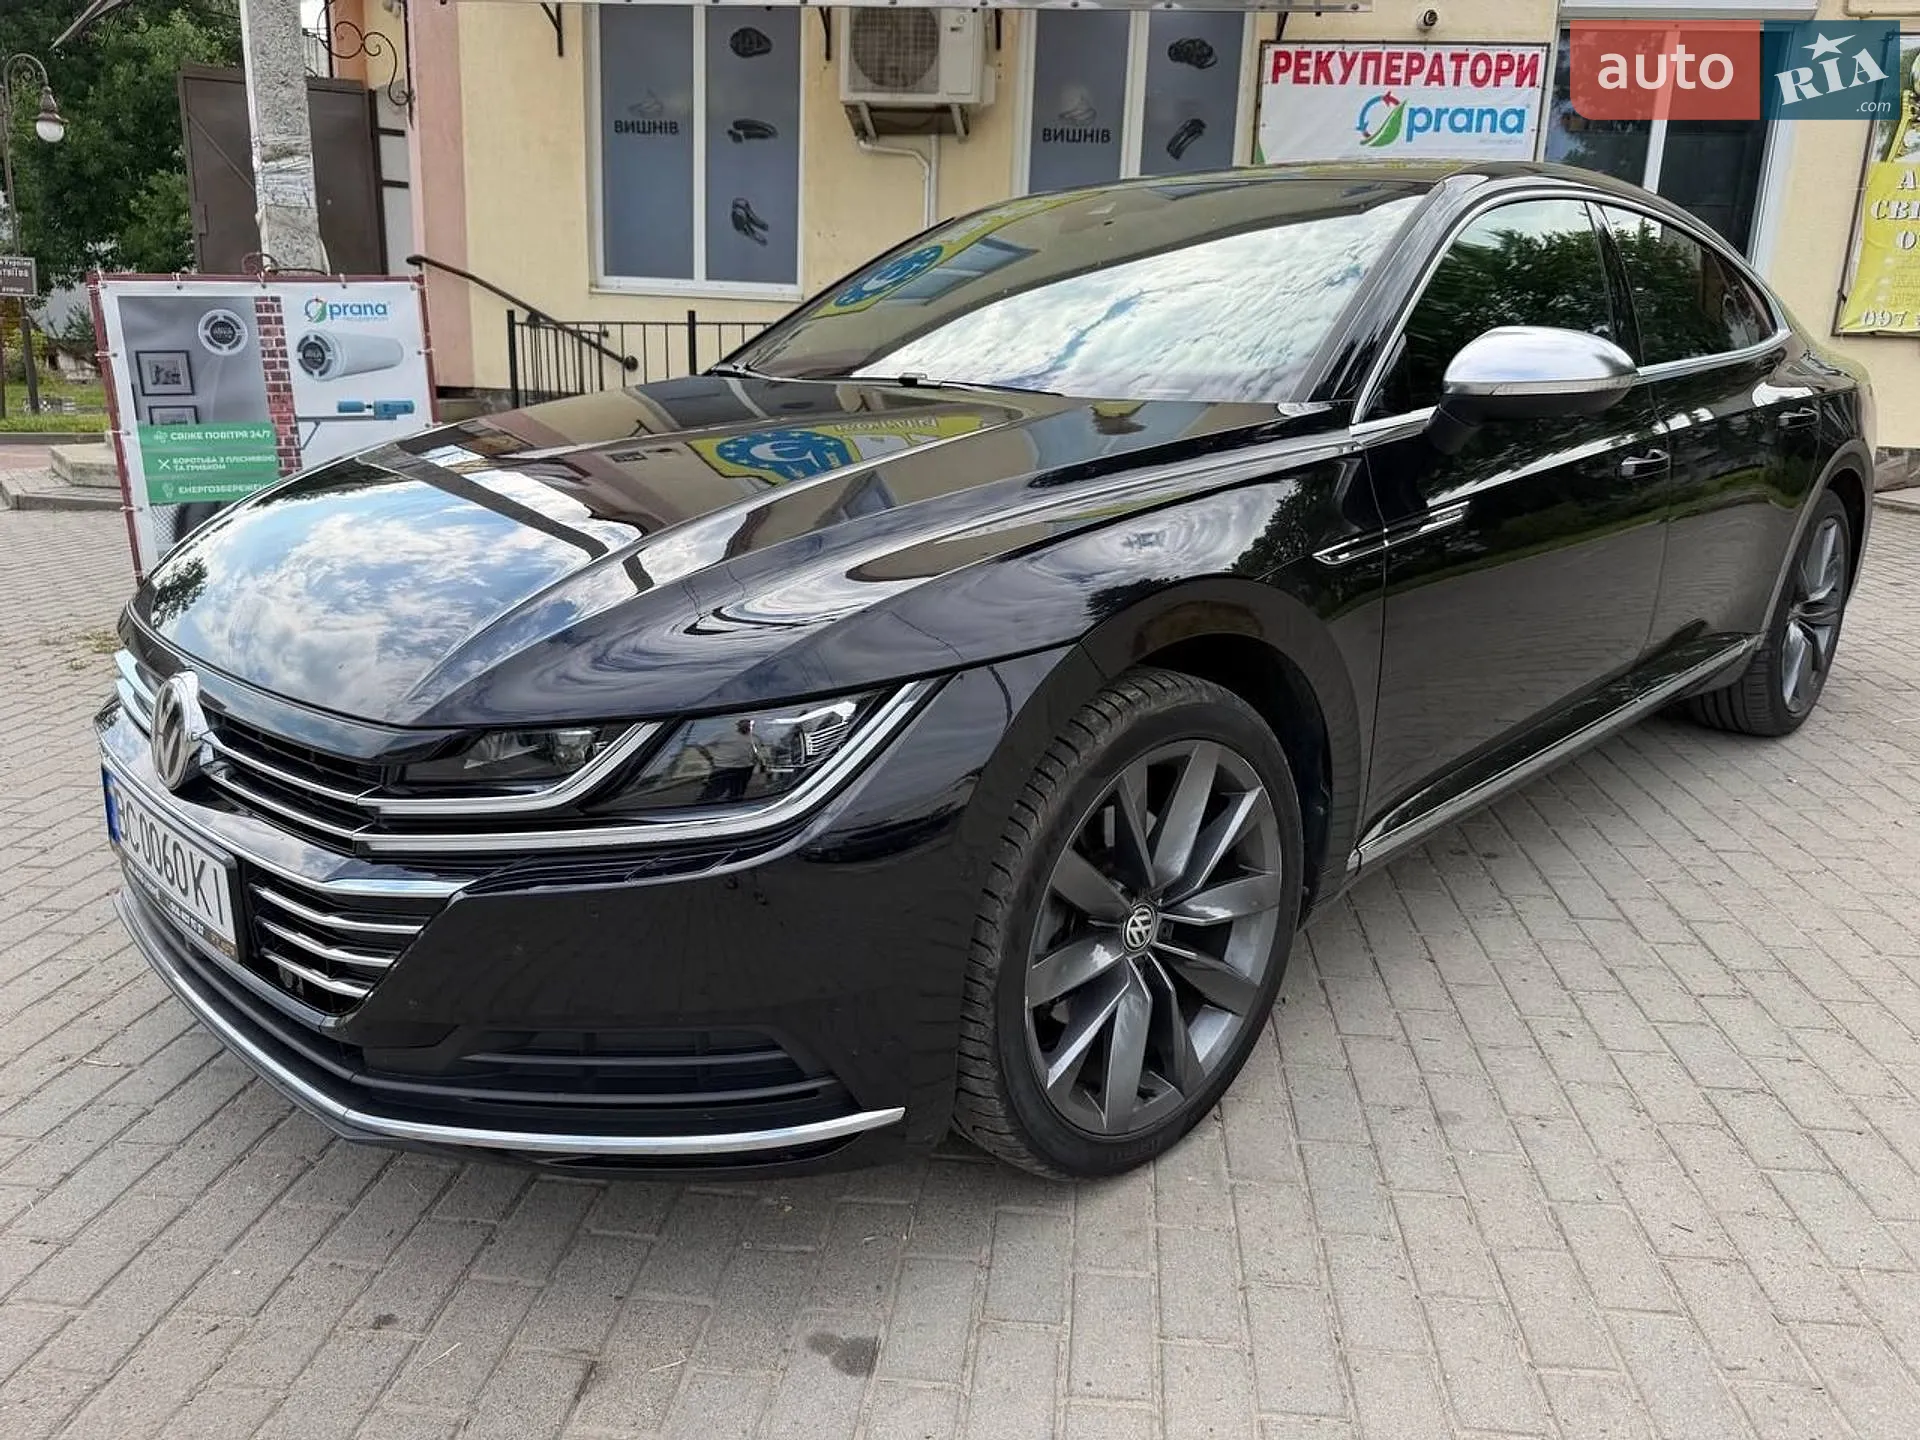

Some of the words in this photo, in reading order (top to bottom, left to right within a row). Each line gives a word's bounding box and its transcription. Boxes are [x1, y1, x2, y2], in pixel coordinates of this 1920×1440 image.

[1271, 51, 1541, 88] РЕКУПЕРАТОРИ
[614, 120, 679, 134] ВИШНІВ
[1406, 105, 1527, 143] prana
[1042, 127, 1112, 143] ВИШНІВ
[1896, 229, 1920, 250] О
[329, 301, 388, 320] prana
[1862, 310, 1908, 328] 097
